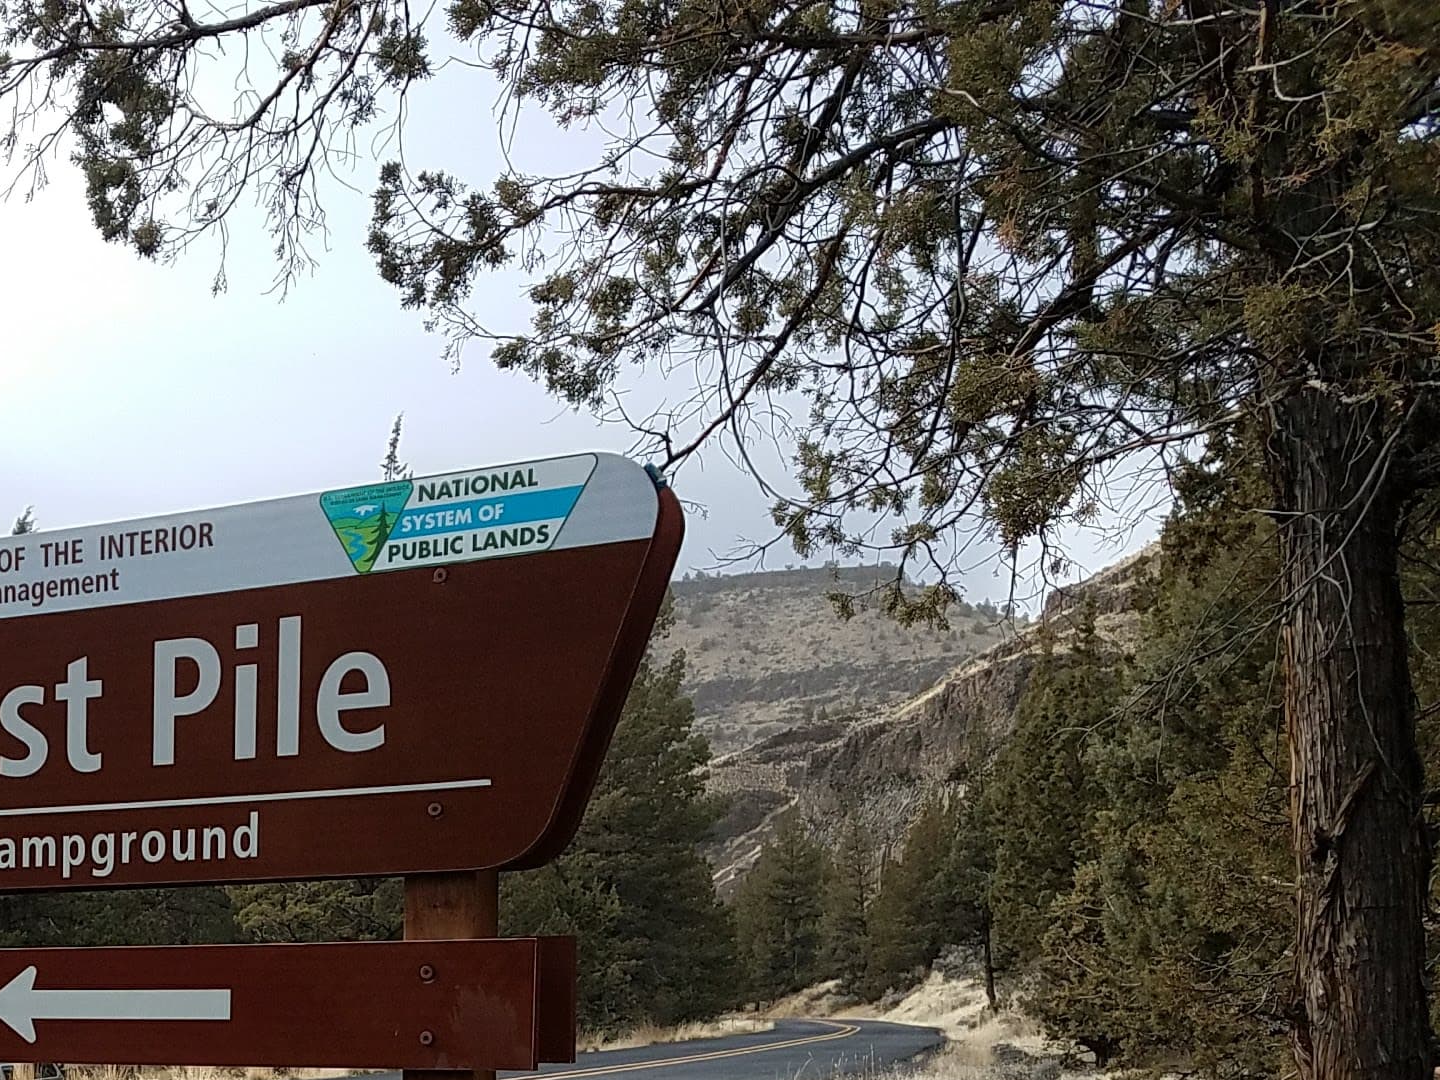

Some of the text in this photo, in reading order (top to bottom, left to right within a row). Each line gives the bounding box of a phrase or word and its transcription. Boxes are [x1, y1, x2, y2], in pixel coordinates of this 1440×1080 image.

[418, 468, 538, 502] NATIONAL
[401, 503, 505, 532] SYSTEM OF
[40, 539, 84, 567] THE
[100, 523, 214, 561] INTERIOR
[387, 524, 550, 562] PUBLIC LANDS
[152, 615, 391, 767] Pile
